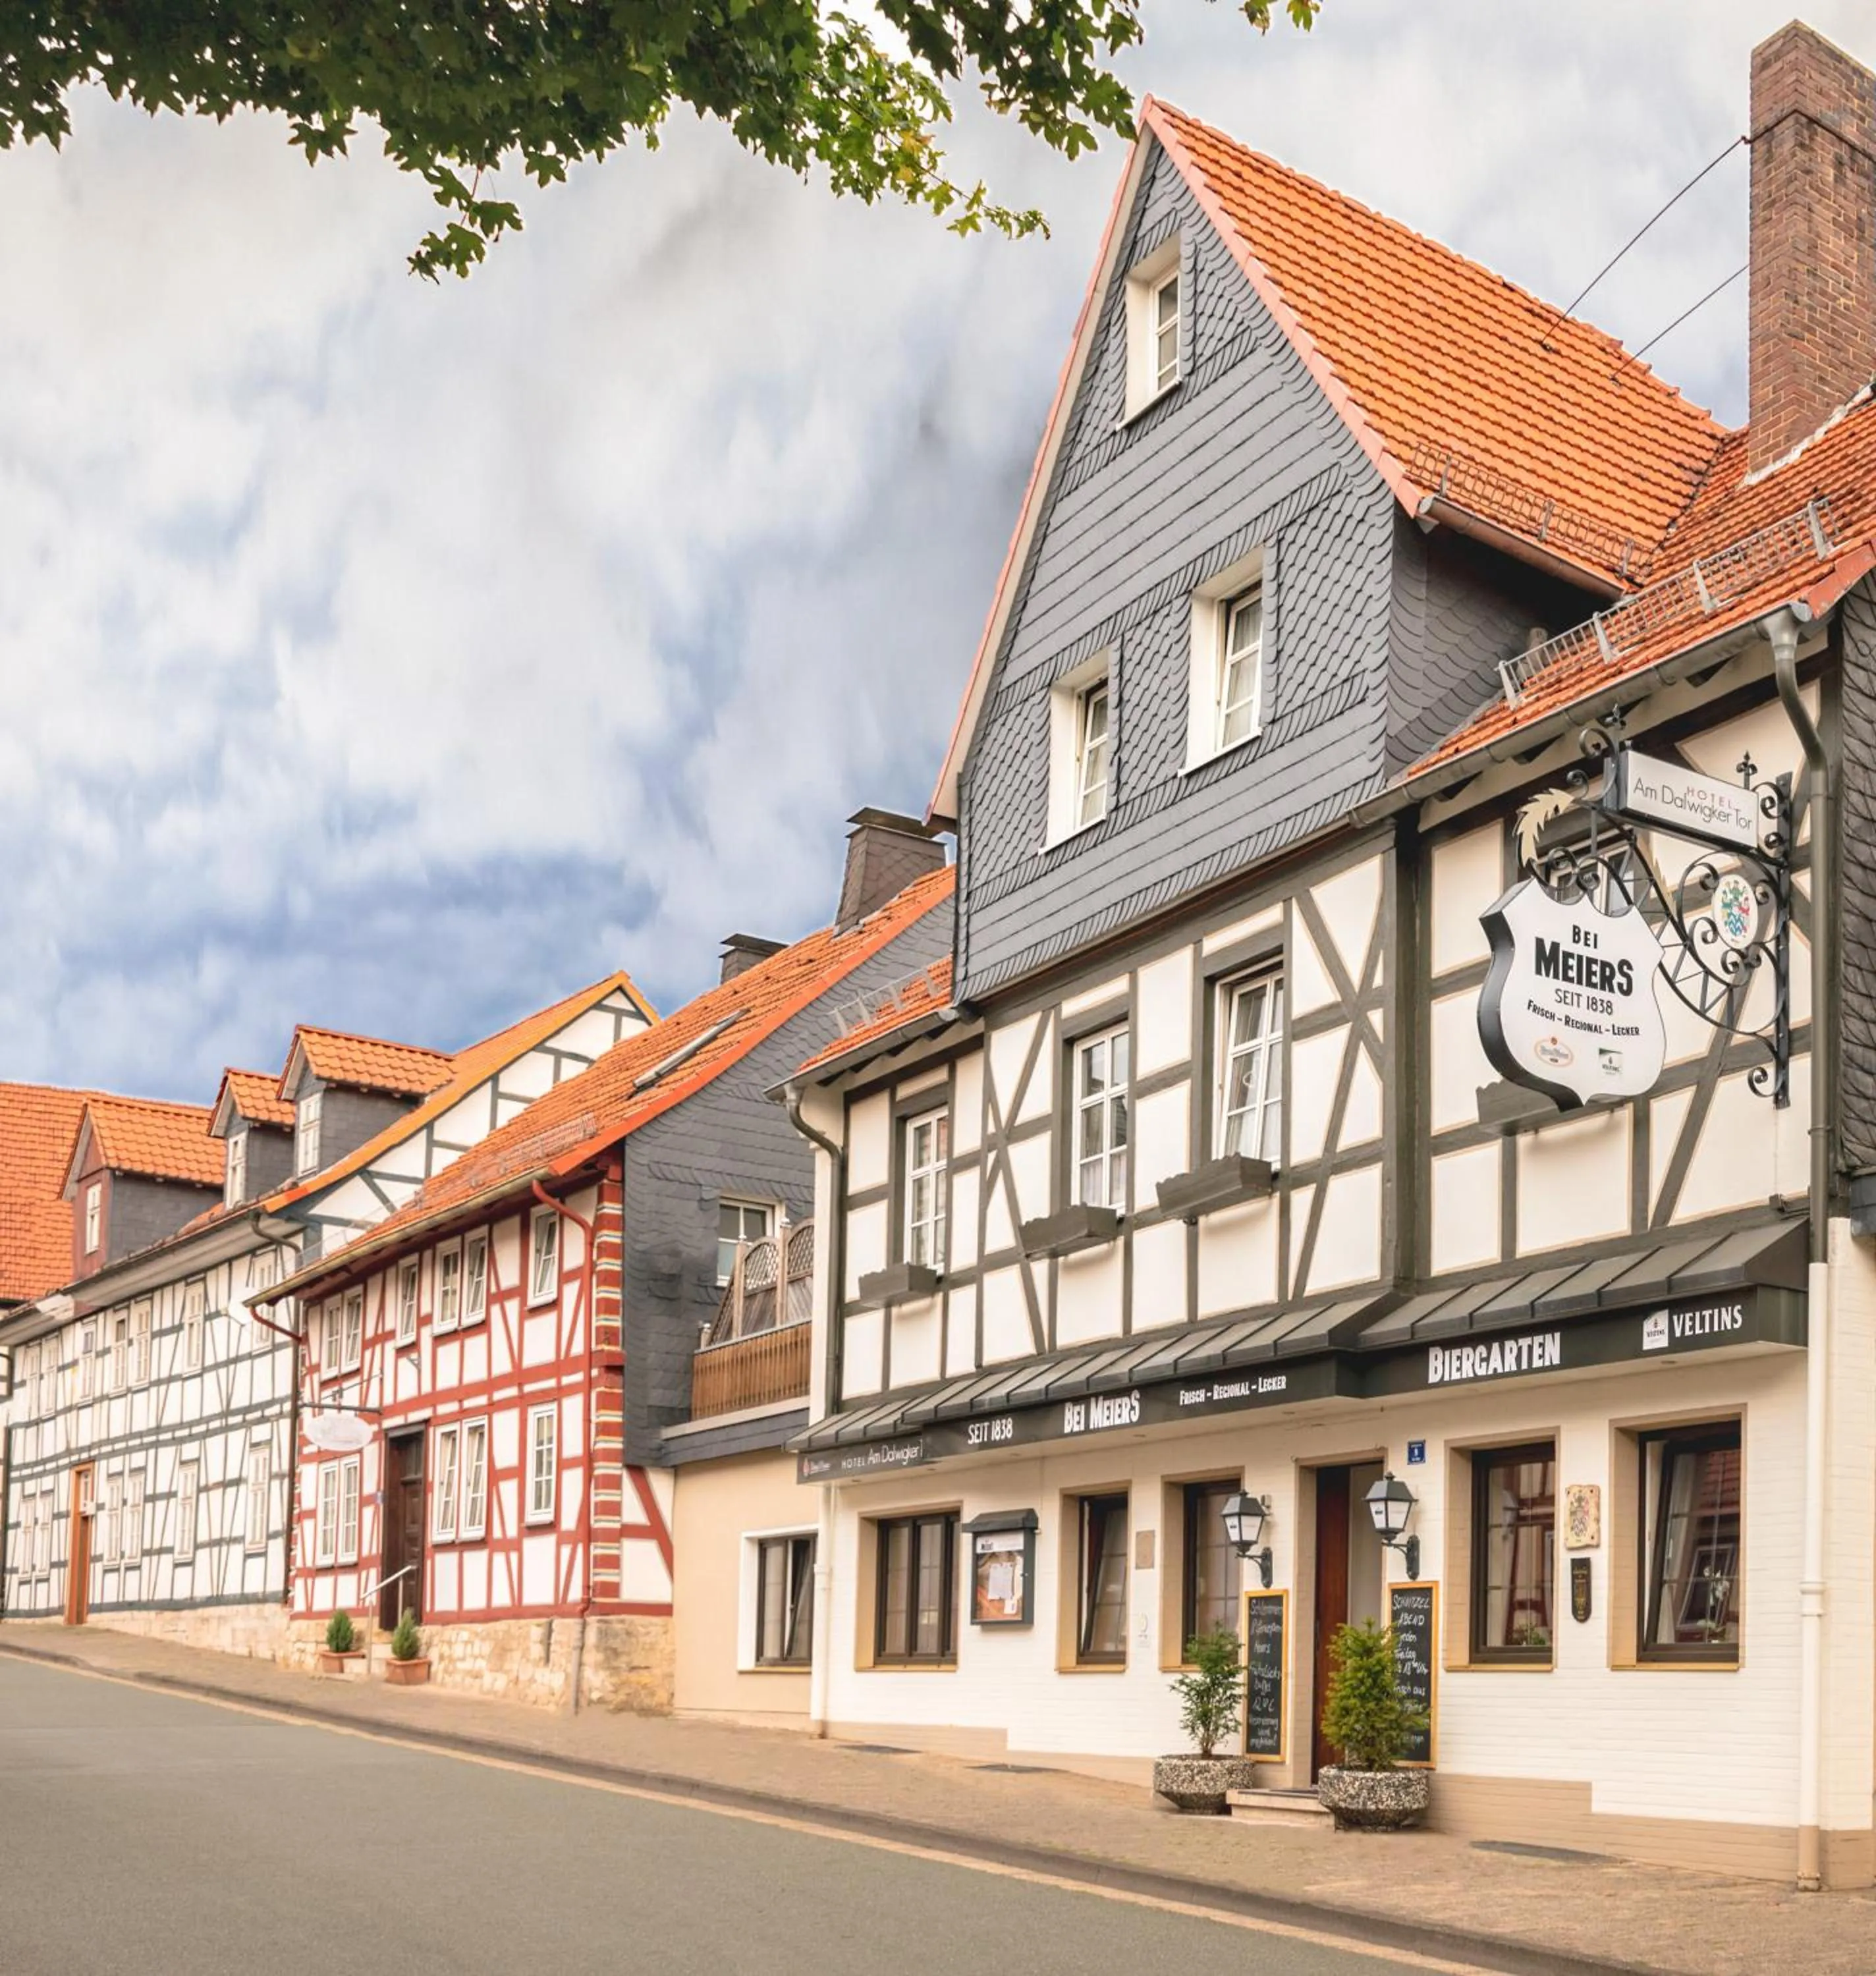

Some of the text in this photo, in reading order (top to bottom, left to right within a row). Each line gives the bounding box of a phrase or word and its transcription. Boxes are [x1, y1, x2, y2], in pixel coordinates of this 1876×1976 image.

[1633, 777, 1753, 830] Am Dalwigker Tor
[1687, 786, 1732, 809] HOTEL
[1572, 924, 1598, 949] BEI
[1535, 936, 1634, 997] MEIERS
[1527, 999, 1555, 1022] FRISCH
[1564, 1014, 1603, 1035] REGIONAL
[1612, 1024, 1640, 1036] LECKER
[1555, 988, 1614, 1016] SEIT 1838
[1672, 1304, 1742, 1338] VELTINS
[1428, 1331, 1561, 1384] BIERGARTEN
[1180, 1388, 1206, 1406] FRISCH
[1213, 1381, 1250, 1400] REGIONAL
[1257, 1375, 1286, 1393] LECKER
[1064, 1389, 1141, 1434] BEI MEIERS
[968, 1417, 1014, 1444] SEIT 1838
[841, 1457, 866, 1469] HOTEL
[867, 1448, 881, 1465] Am
[881, 1443, 920, 1466] Dalwigker
